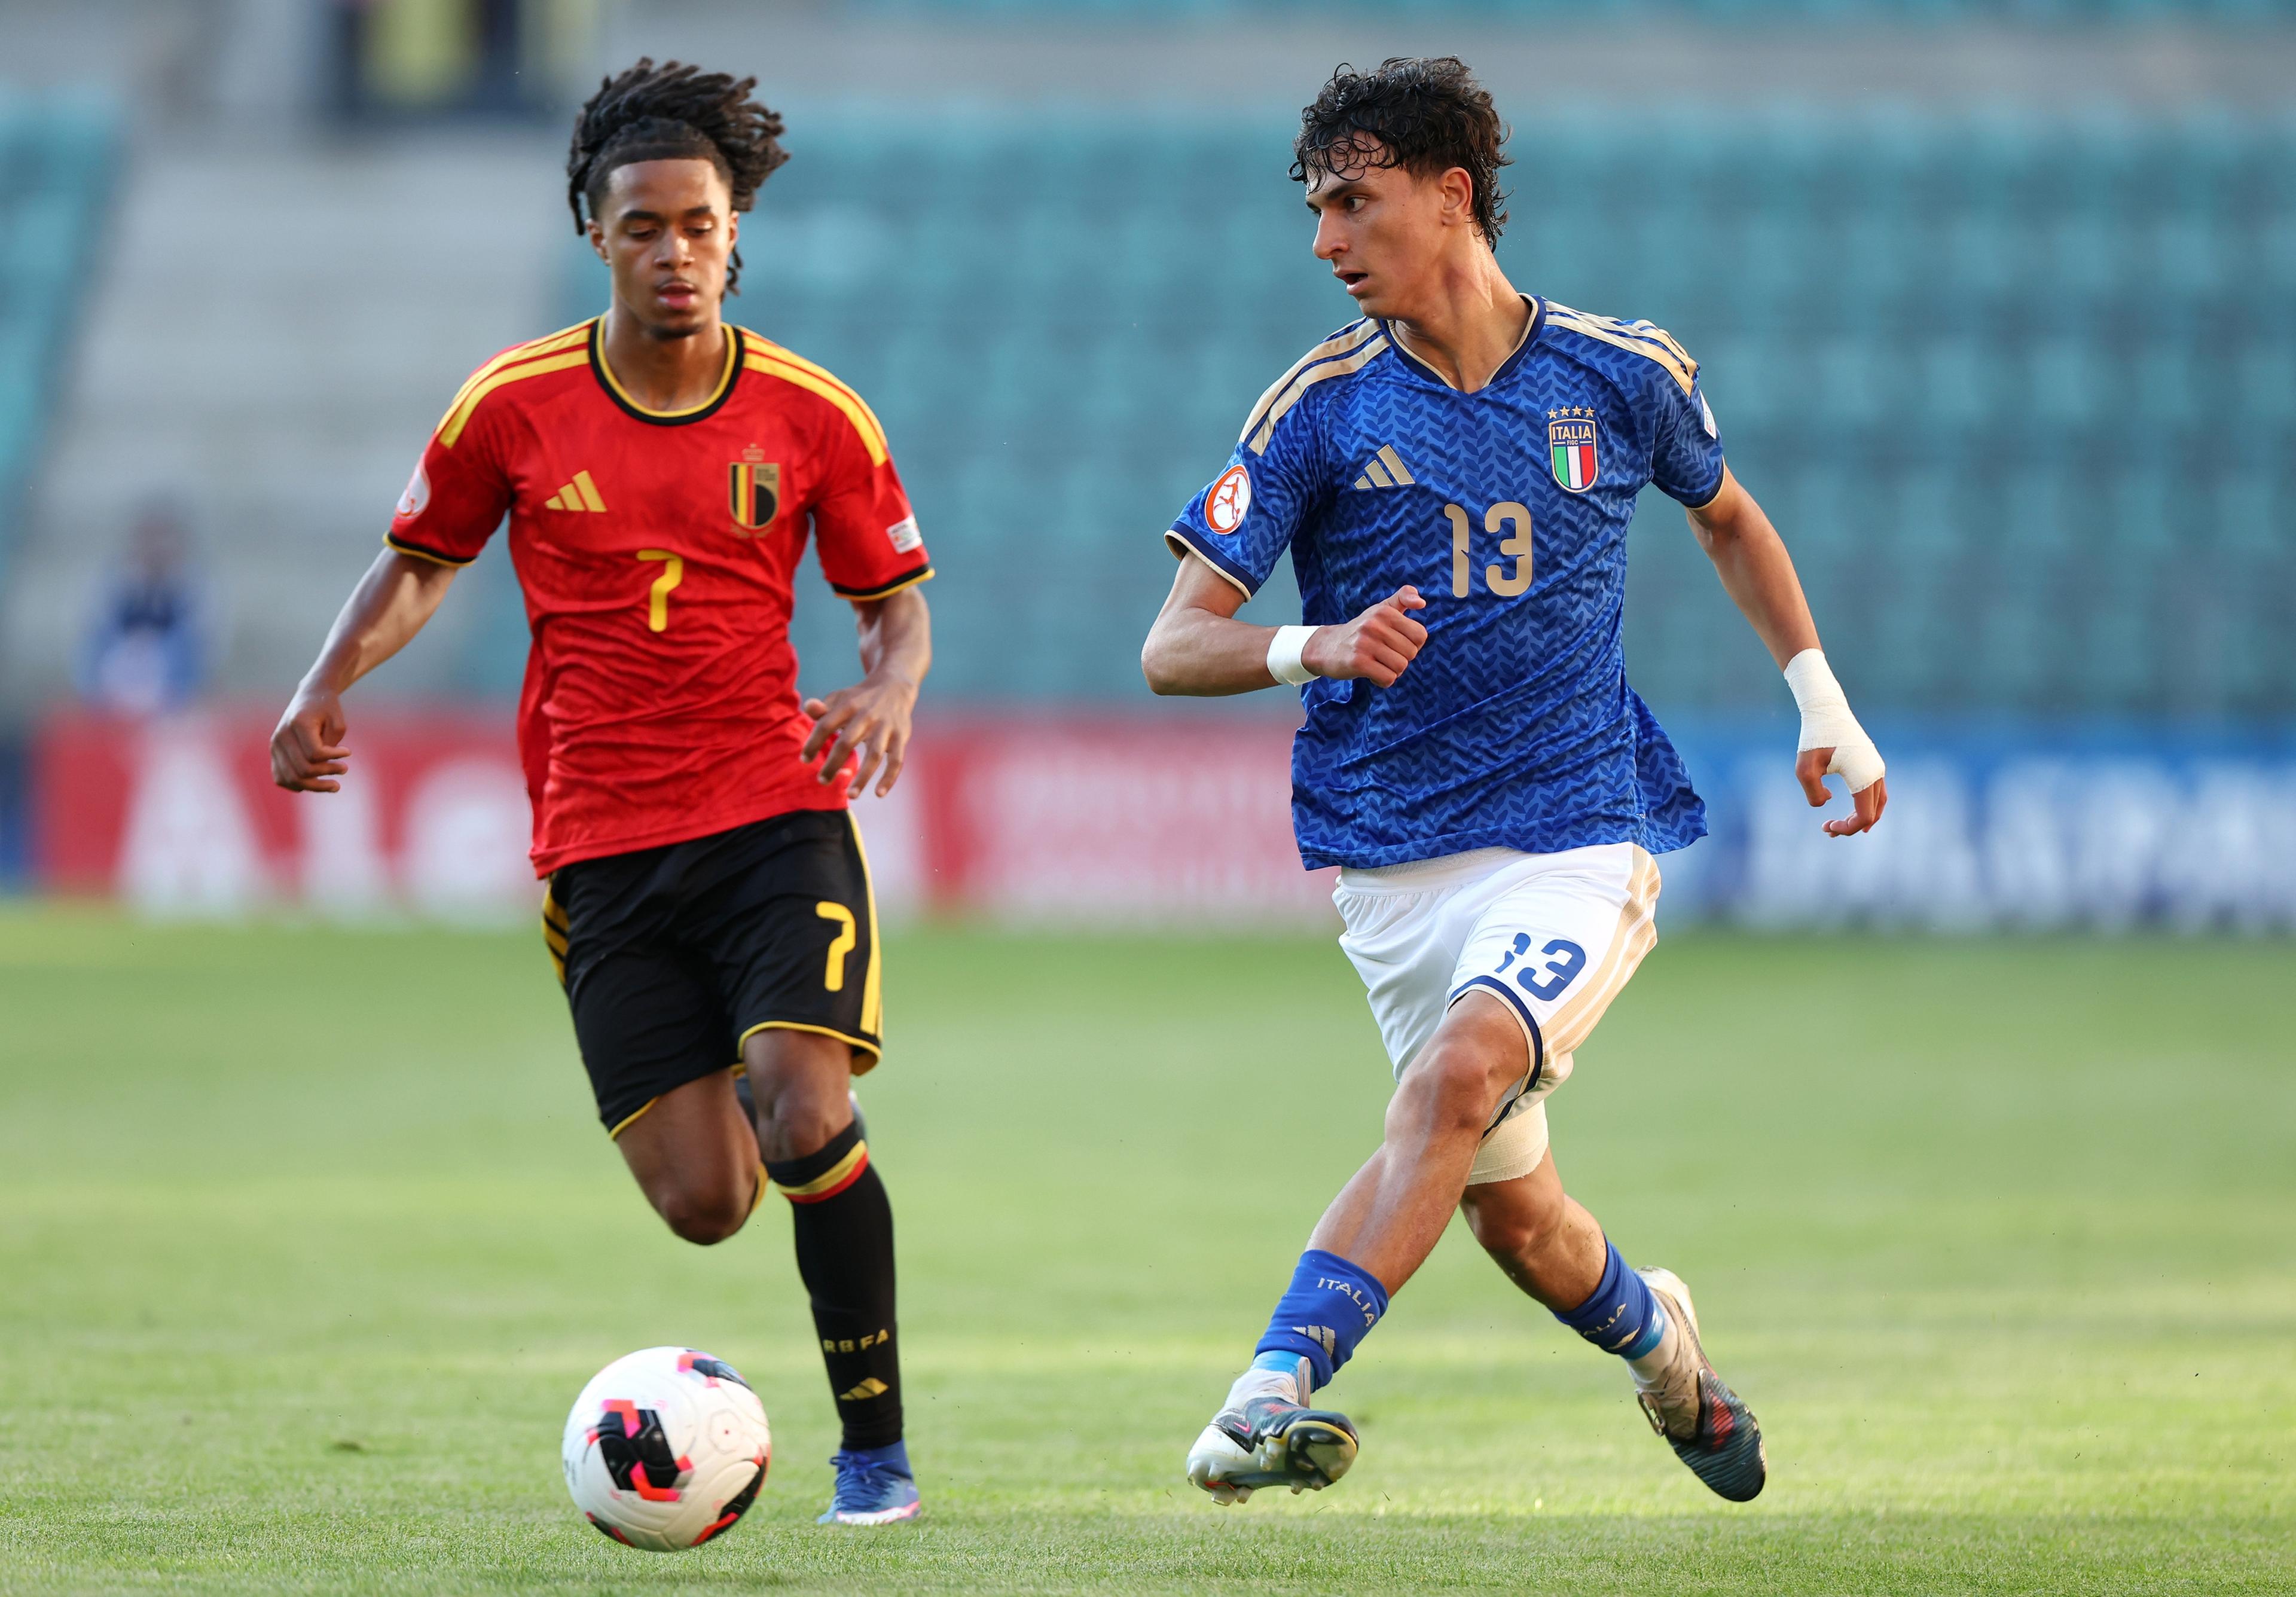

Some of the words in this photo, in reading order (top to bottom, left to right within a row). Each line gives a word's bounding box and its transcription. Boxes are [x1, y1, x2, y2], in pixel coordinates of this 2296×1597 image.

[1552, 425, 1592, 440] ITALIA
[1444, 501, 1532, 598] 13
[636, 549, 683, 632] 7
[815, 900, 856, 992] 7
[1494, 932, 1586, 1001] 13
[1317, 1277, 1375, 1327] ITALIA
[823, 1329, 889, 1353] RBFA
